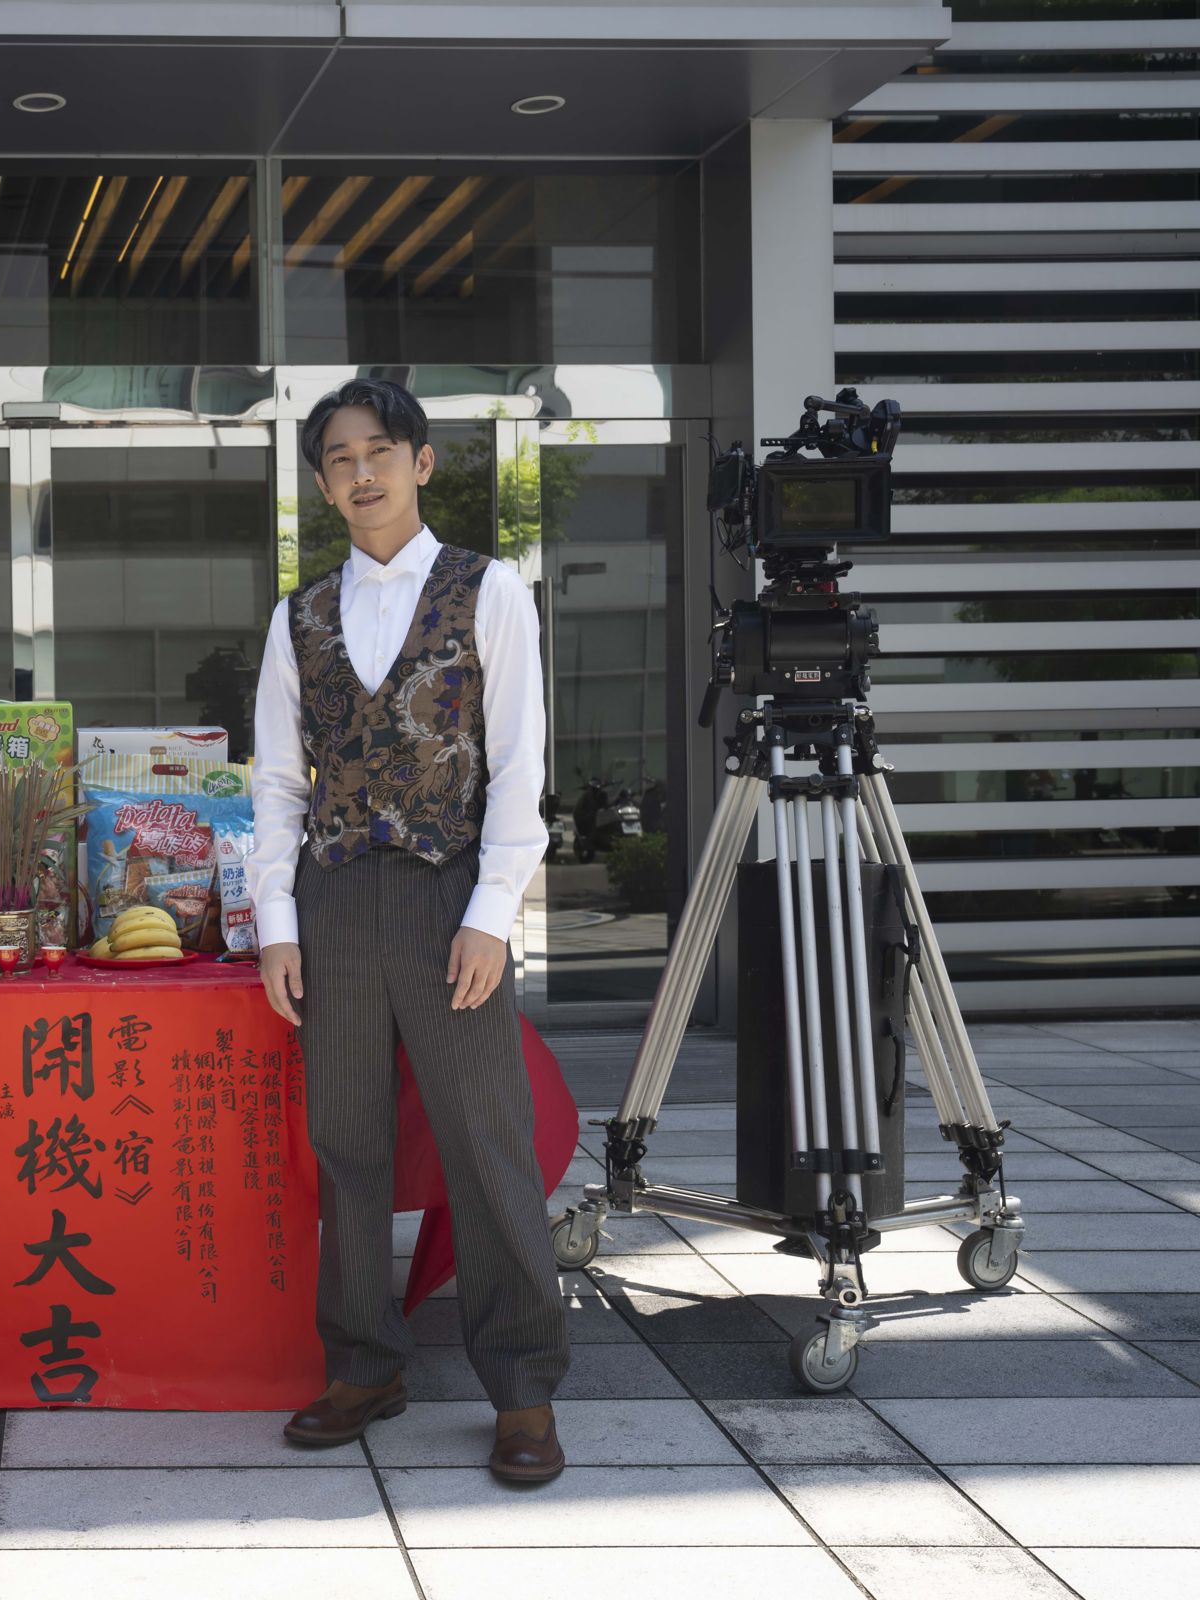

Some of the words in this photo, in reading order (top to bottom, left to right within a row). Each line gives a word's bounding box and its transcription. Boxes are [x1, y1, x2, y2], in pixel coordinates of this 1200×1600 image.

[115, 800, 197, 833] patata
[222, 867, 245, 881] 奶油
[224, 887, 247, 899] バタ
[0, 1083, 15, 1120] 主演
[216, 1028, 237, 1112] 製作公司
[240, 1049, 263, 1191] 文化內容策進院
[13, 1012, 117, 1402] 開機大吉
[194, 1052, 218, 1304] 網銀國際影視股份有限公司
[262, 1050, 287, 1292] 網銀國際影視股份有限公司
